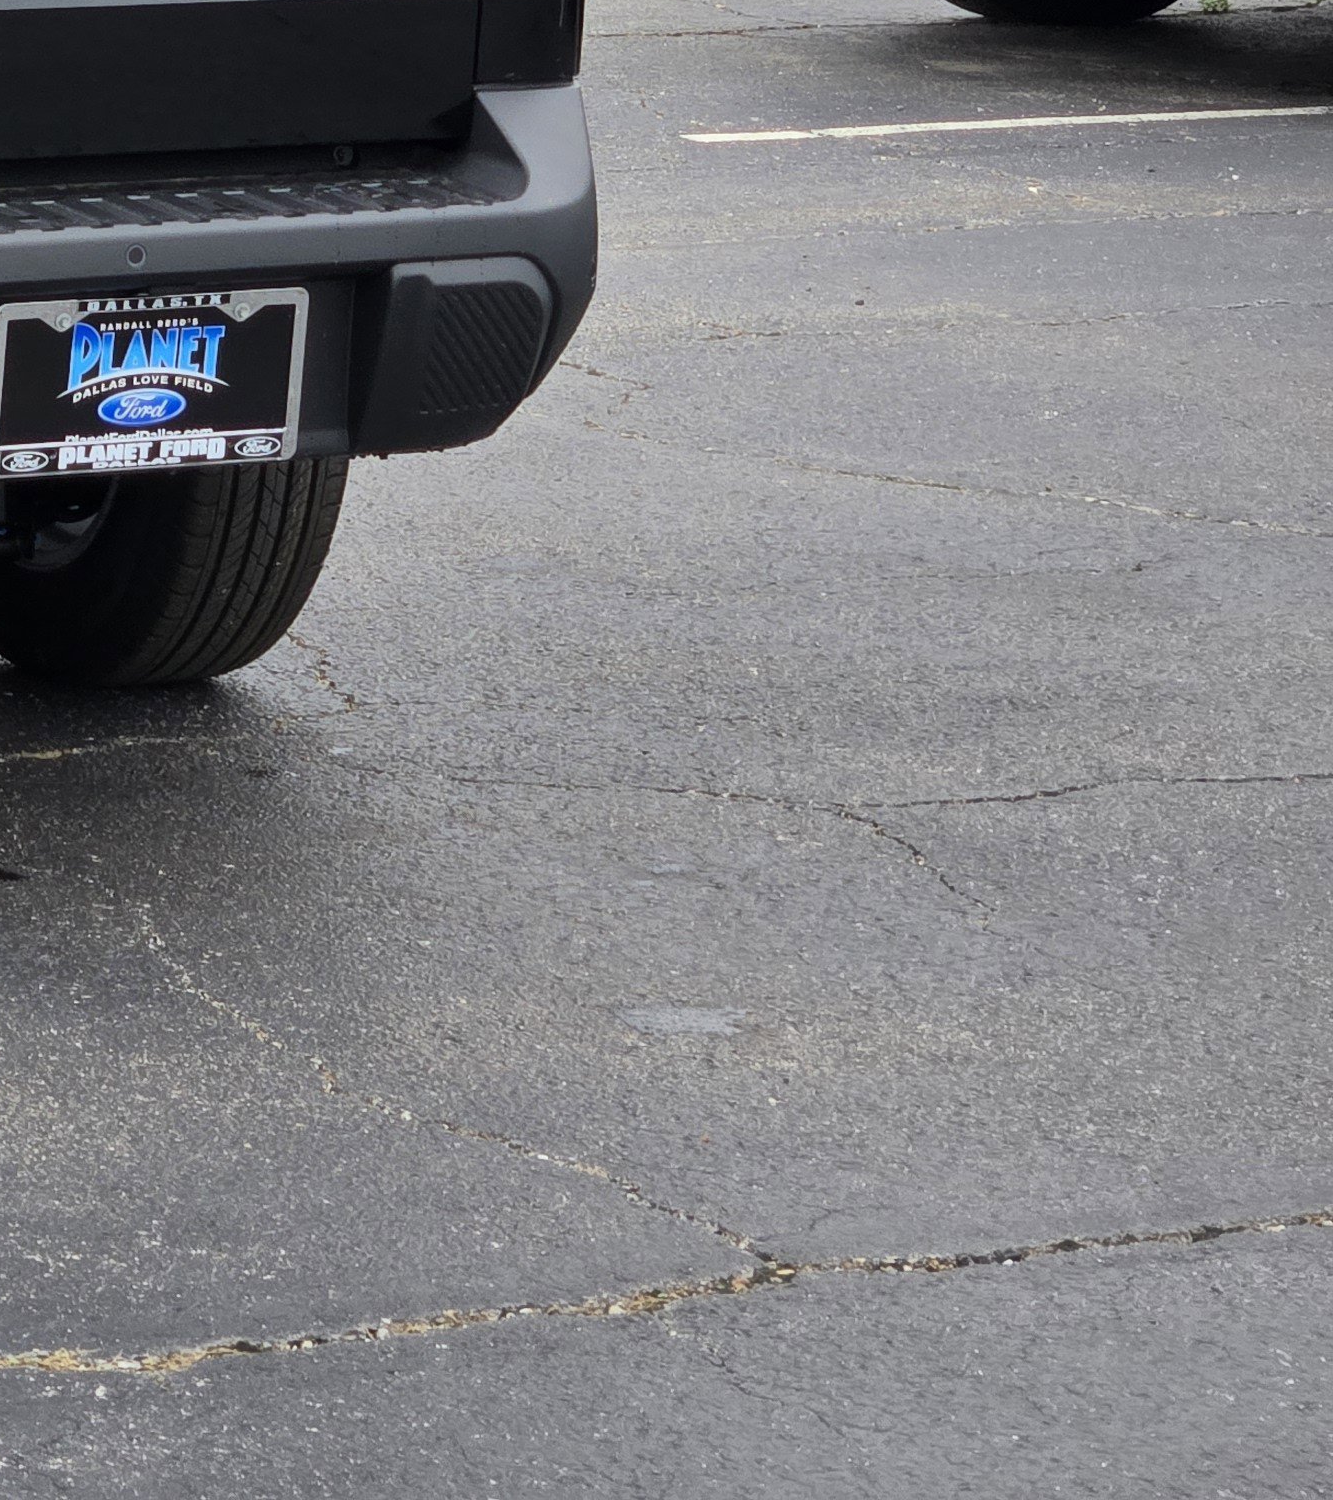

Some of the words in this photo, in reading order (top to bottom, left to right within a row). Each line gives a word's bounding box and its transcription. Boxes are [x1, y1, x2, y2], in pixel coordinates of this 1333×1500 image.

[194, 294, 222, 306] TX
[100, 320, 152, 332] RANDALL
[67, 322, 226, 391] PLANET
[72, 377, 127, 404] DALLAS
[133, 374, 169, 386] LOVE
[174, 375, 214, 394] FIELD
[114, 395, 169, 420] Ford
[58, 440, 154, 470] PLANET
[159, 437, 226, 460] FORD
[242, 439, 274, 454] Ford
[10, 454, 39, 470] Ford
